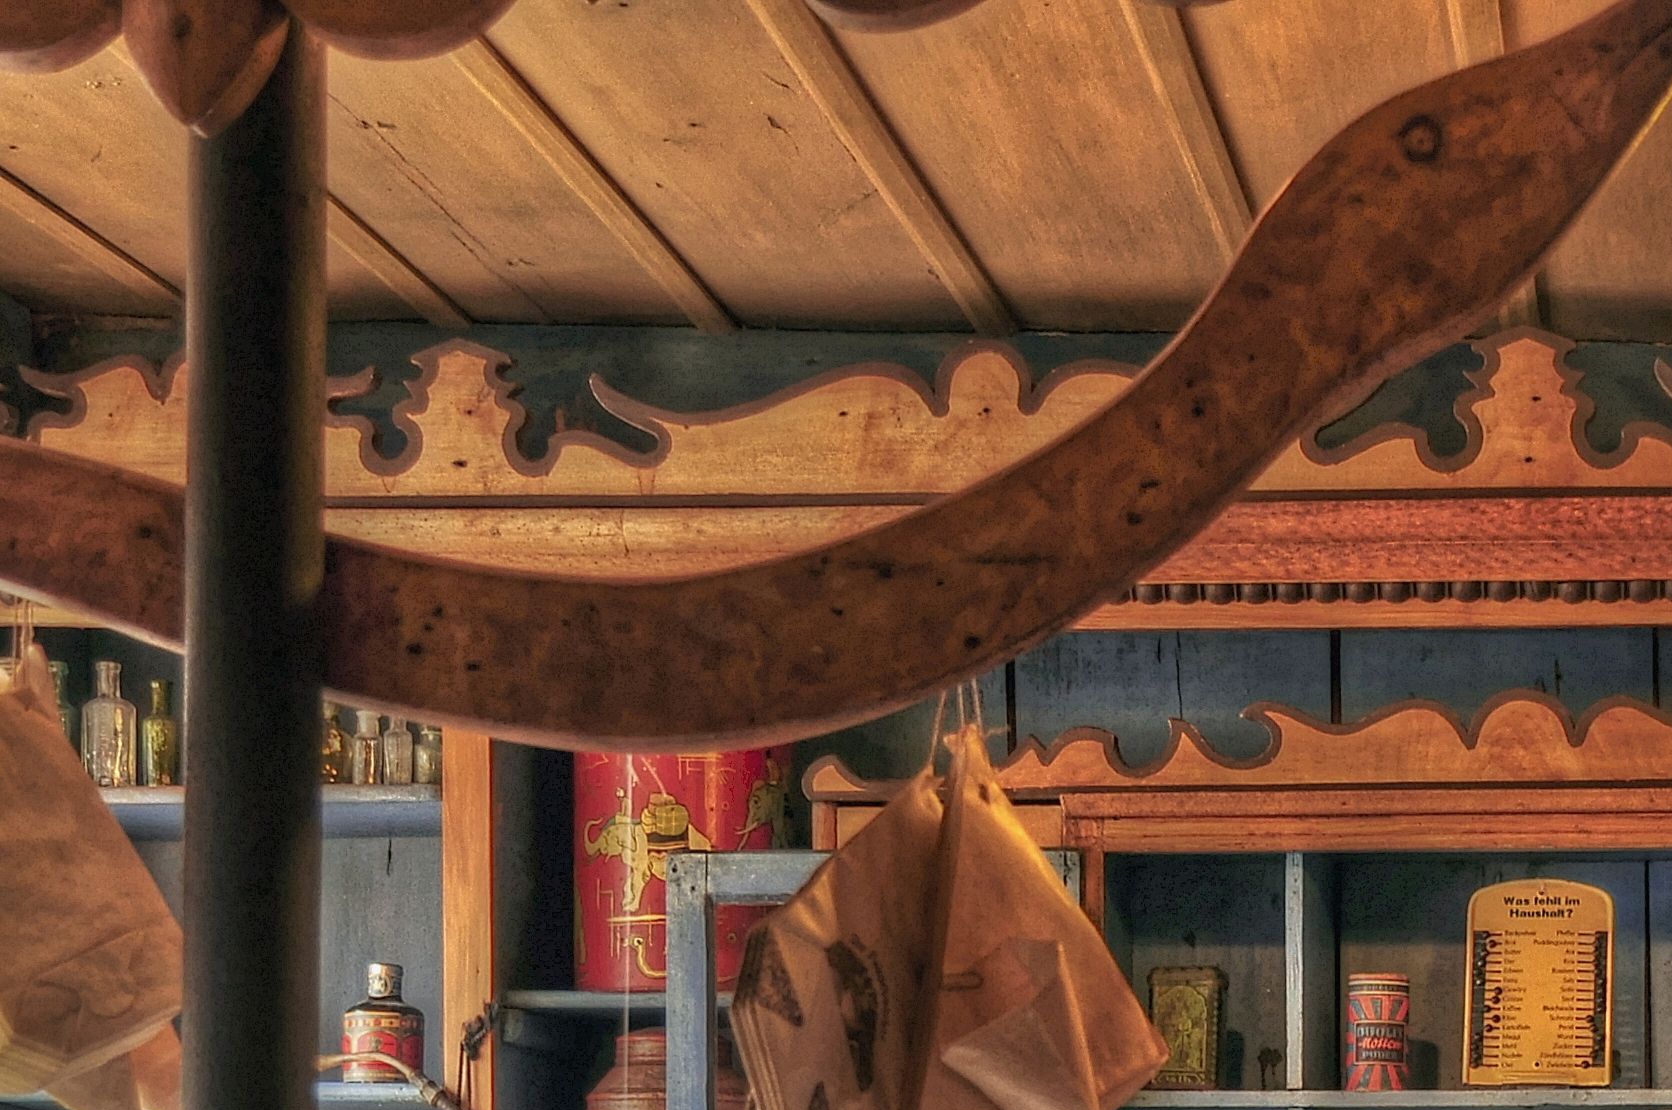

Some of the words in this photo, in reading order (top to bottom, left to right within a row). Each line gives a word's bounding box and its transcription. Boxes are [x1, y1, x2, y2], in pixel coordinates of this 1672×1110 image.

[1503, 896, 1530, 906] Was
[1534, 896, 1561, 906] fehlt
[1564, 896, 1581, 906] im
[1509, 908, 1574, 919] Haushalt?
